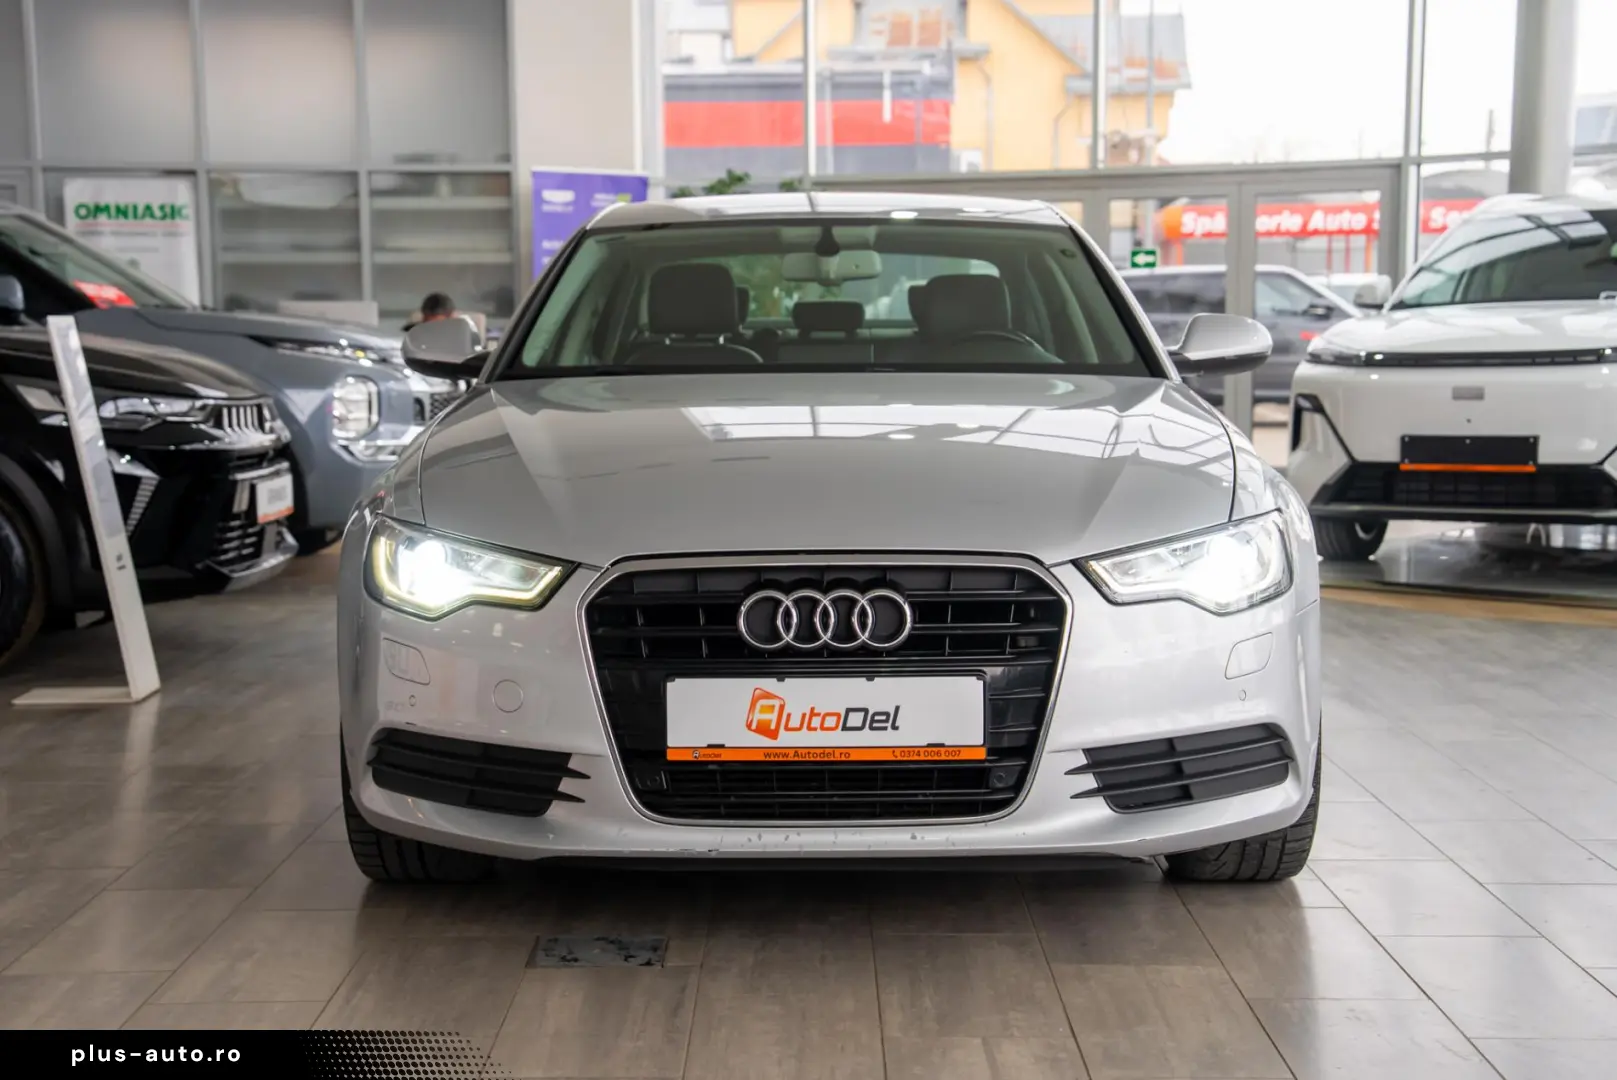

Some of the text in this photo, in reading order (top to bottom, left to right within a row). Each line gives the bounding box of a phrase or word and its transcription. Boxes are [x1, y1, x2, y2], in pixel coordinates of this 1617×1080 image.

[1307, 209, 1368, 232] Auto
[747, 690, 900, 737] AutoDel
[763, 750, 961, 759] www.Autodel.ro 0374 006 007
